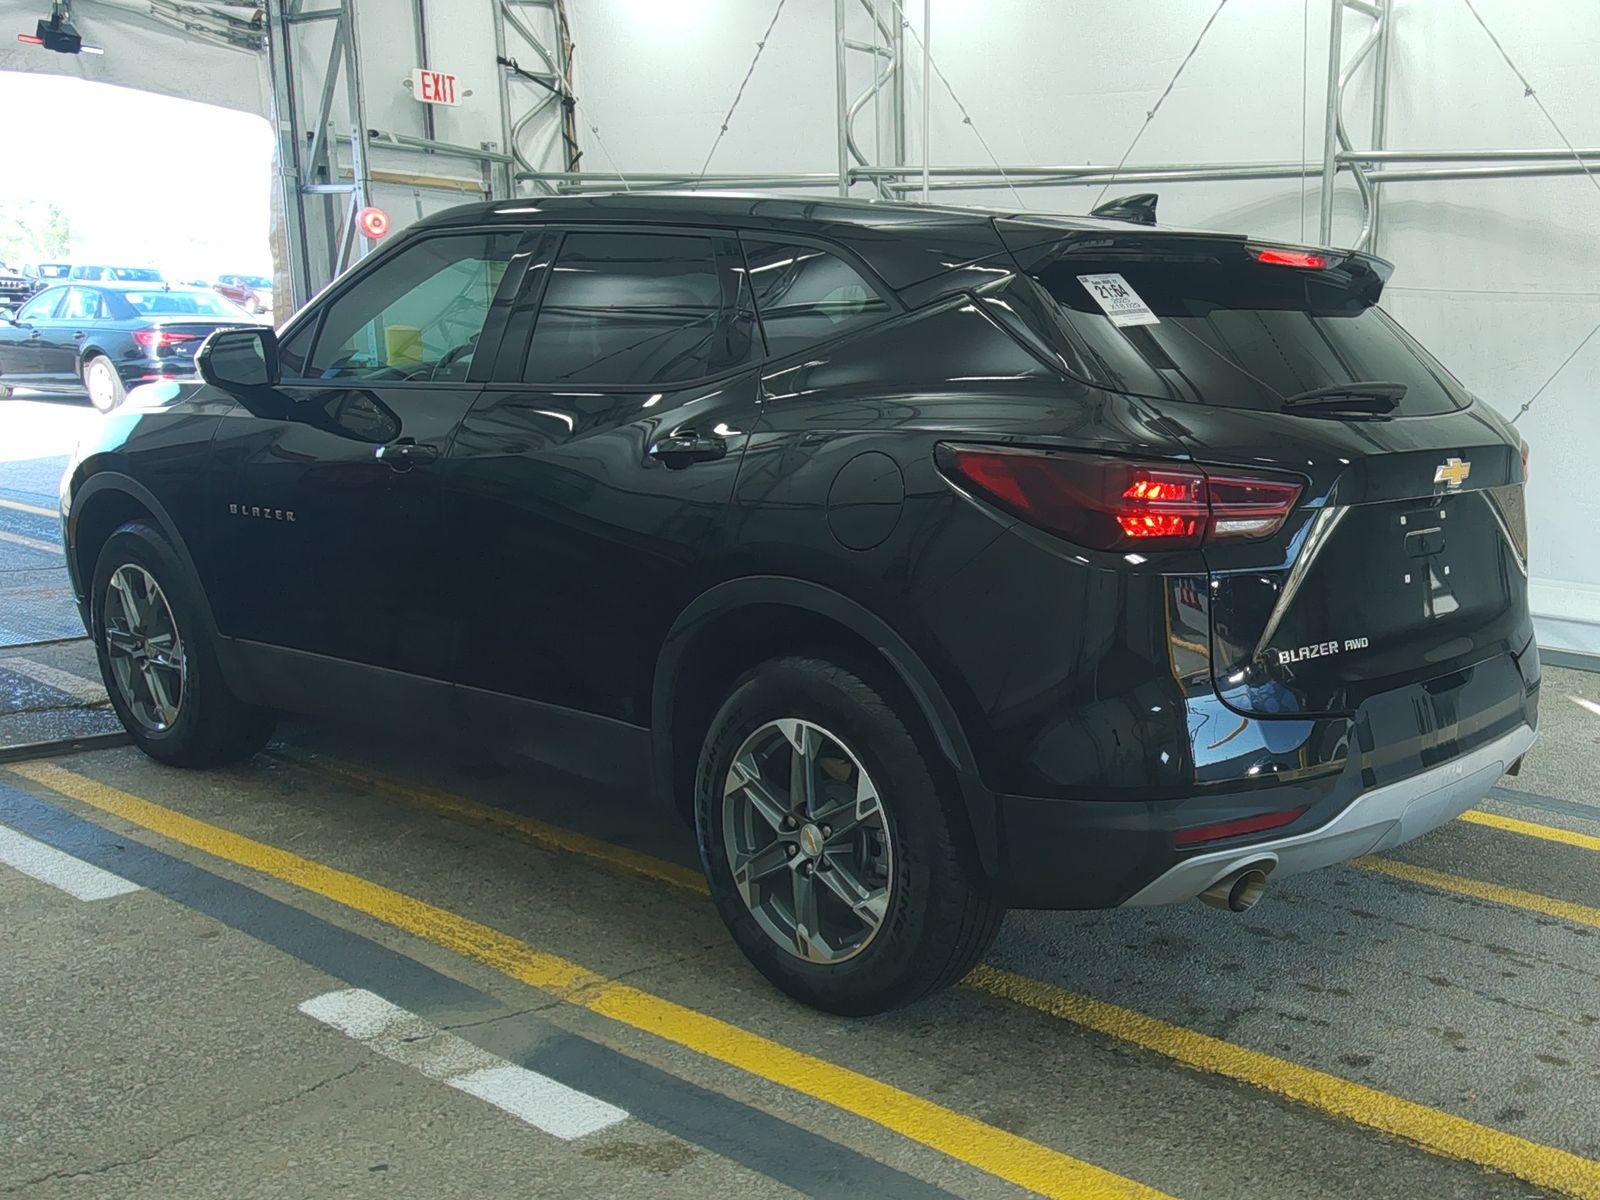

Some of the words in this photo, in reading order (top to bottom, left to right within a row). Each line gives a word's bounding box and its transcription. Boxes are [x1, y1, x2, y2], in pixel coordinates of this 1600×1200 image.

[421, 71, 456, 103] EXIT
[229, 503, 296, 522] BLAZER
[1278, 640, 1339, 665] BLAZER
[1344, 637, 1369, 651] AWD
